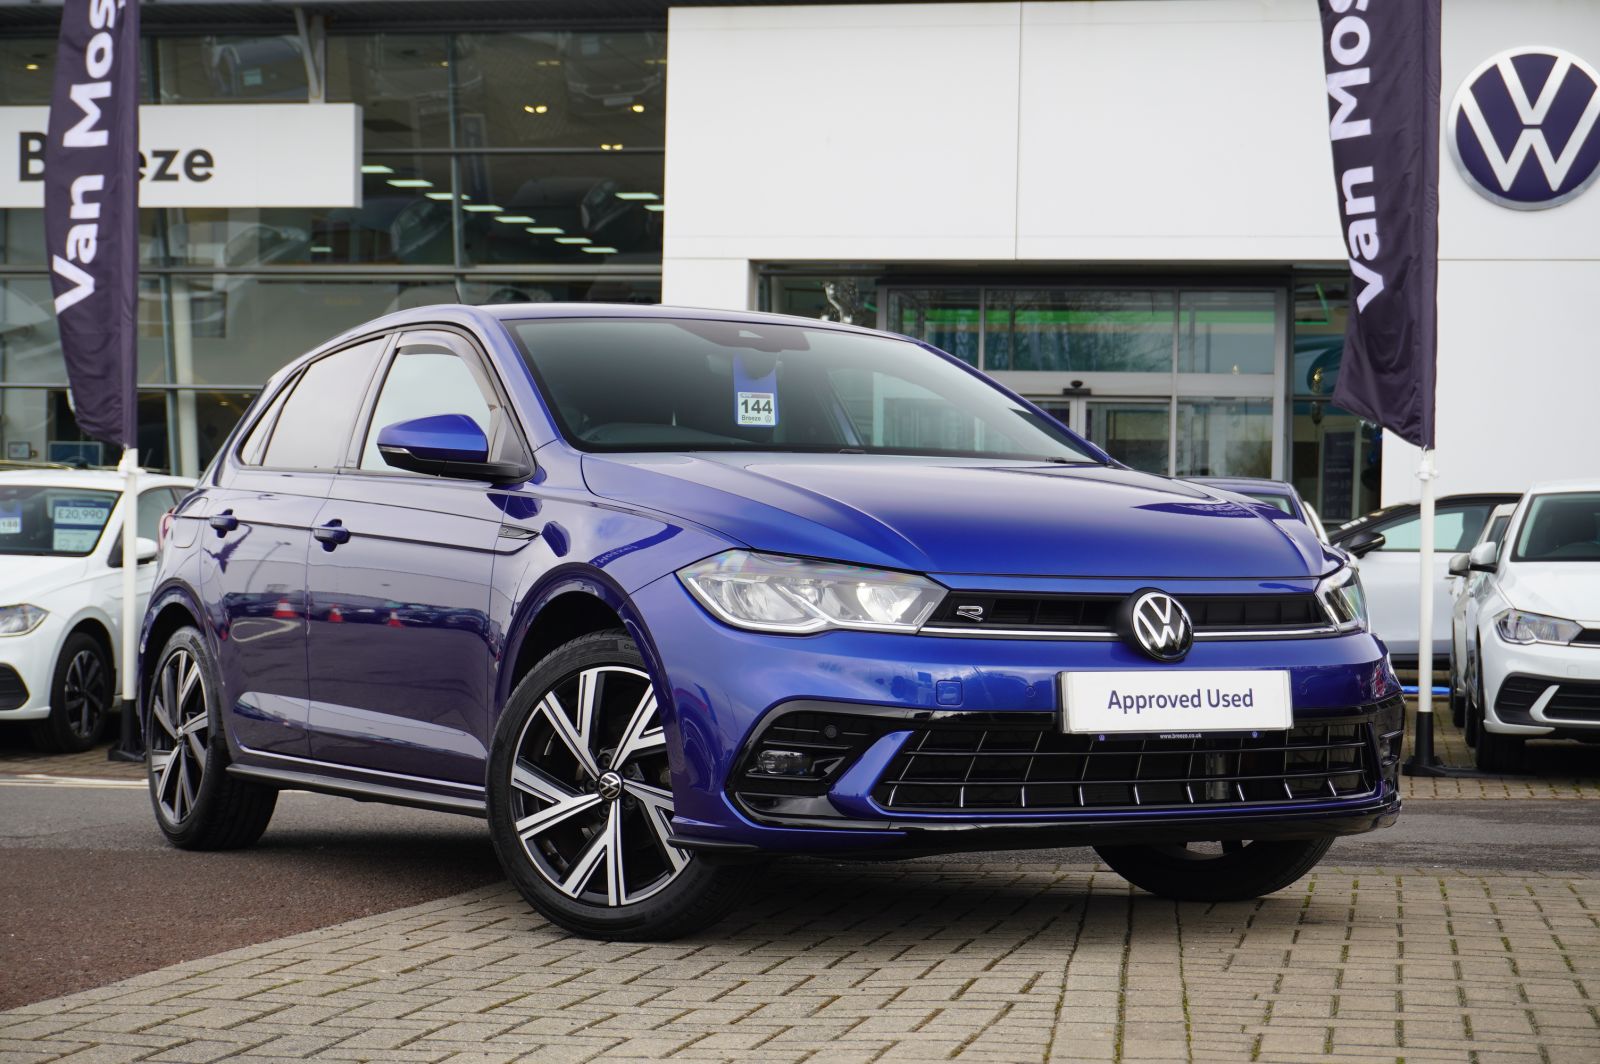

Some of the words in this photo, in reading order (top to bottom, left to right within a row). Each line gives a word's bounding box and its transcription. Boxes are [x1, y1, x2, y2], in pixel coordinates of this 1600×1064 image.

[62, 0, 126, 148] Mos
[18, 130, 215, 183] Bze
[52, 174, 105, 315] Van
[1341, 165, 1385, 314] Van
[741, 399, 773, 414] 144
[1107, 688, 1202, 714] Approved
[1206, 687, 1254, 708] Used
[1159, 732, 1202, 740] www.breeze.co.uk
